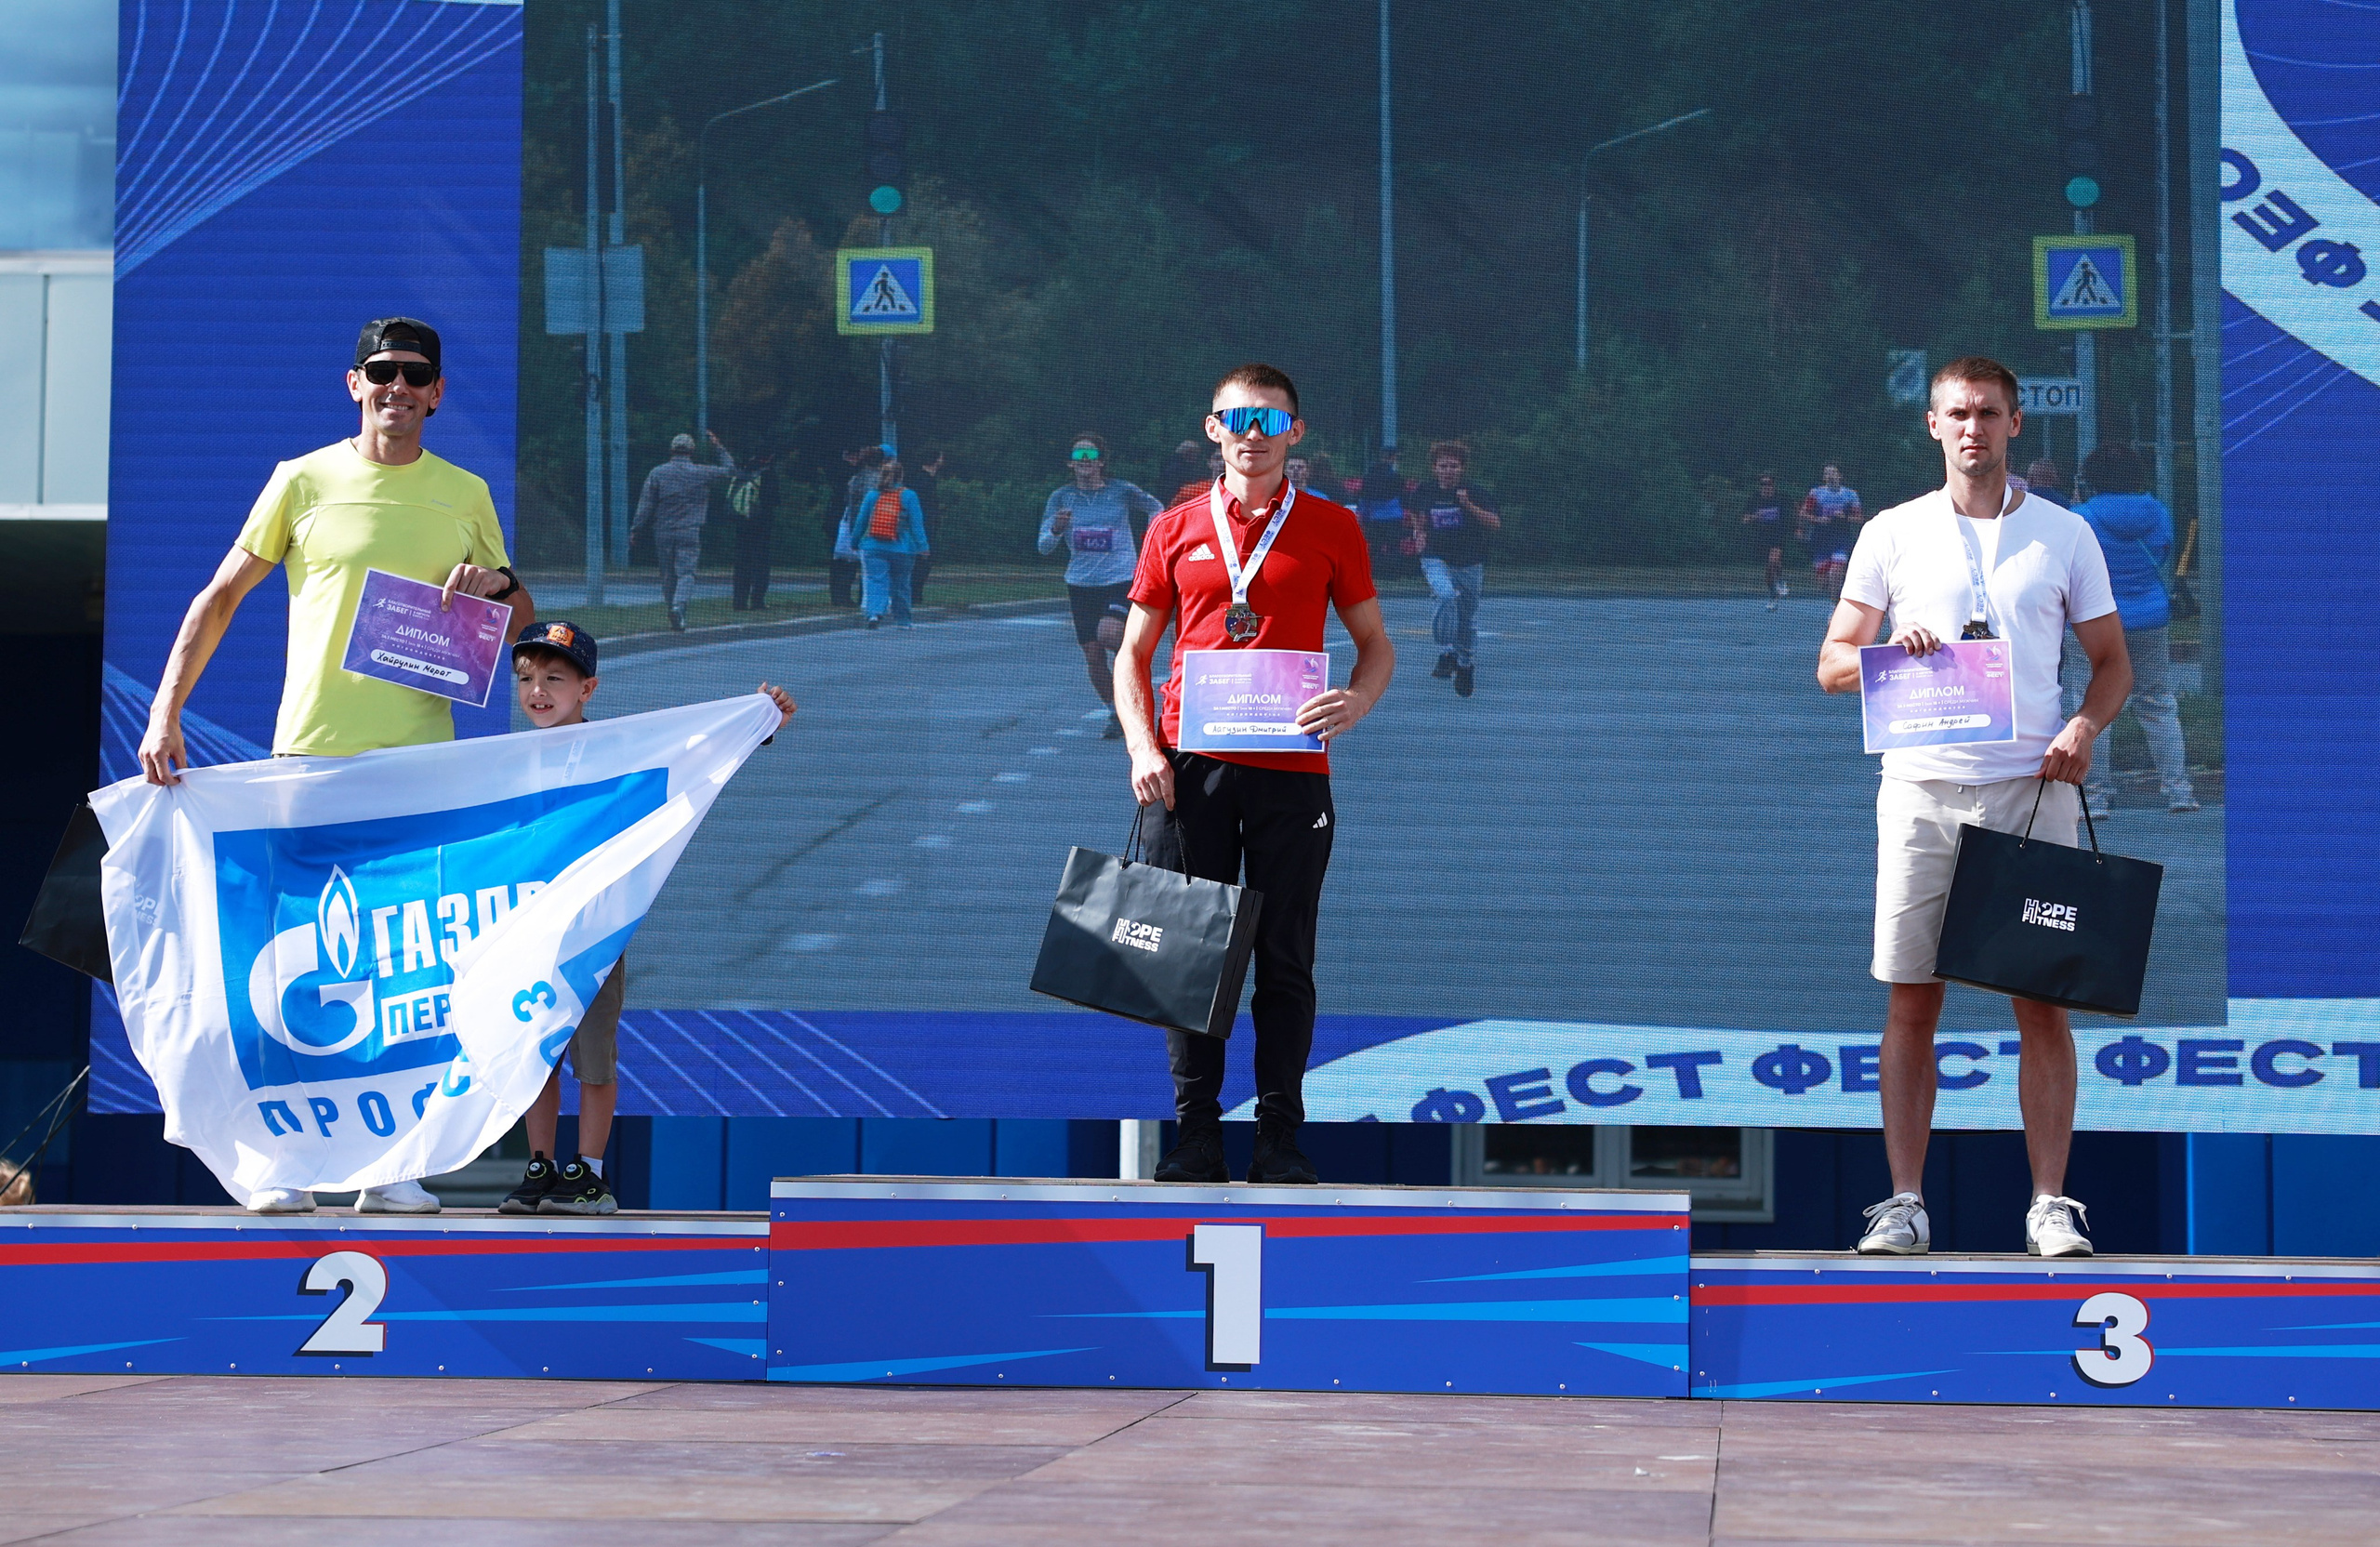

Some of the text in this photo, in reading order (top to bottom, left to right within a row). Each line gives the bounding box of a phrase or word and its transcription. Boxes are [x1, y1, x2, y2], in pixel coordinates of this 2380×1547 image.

[387, 603, 409, 615] ЗАБЕГ
[395, 625, 450, 647] ДИПЛОМ
[1227, 694, 1281, 704] ДИПЛОМ
[1909, 685, 1964, 699] ДИПЛОМ
[2024, 898, 2078, 921] HOPE
[1115, 918, 1163, 943] HOPE
[2022, 913, 2075, 932] FITNESS
[1410, 1051, 1724, 1124] ФЕСТ
[2095, 1036, 2380, 1089] ФЕСТ
[299, 1250, 387, 1353] 2
[1194, 1224, 1262, 1365] 1
[2075, 1291, 2152, 1384] 3
